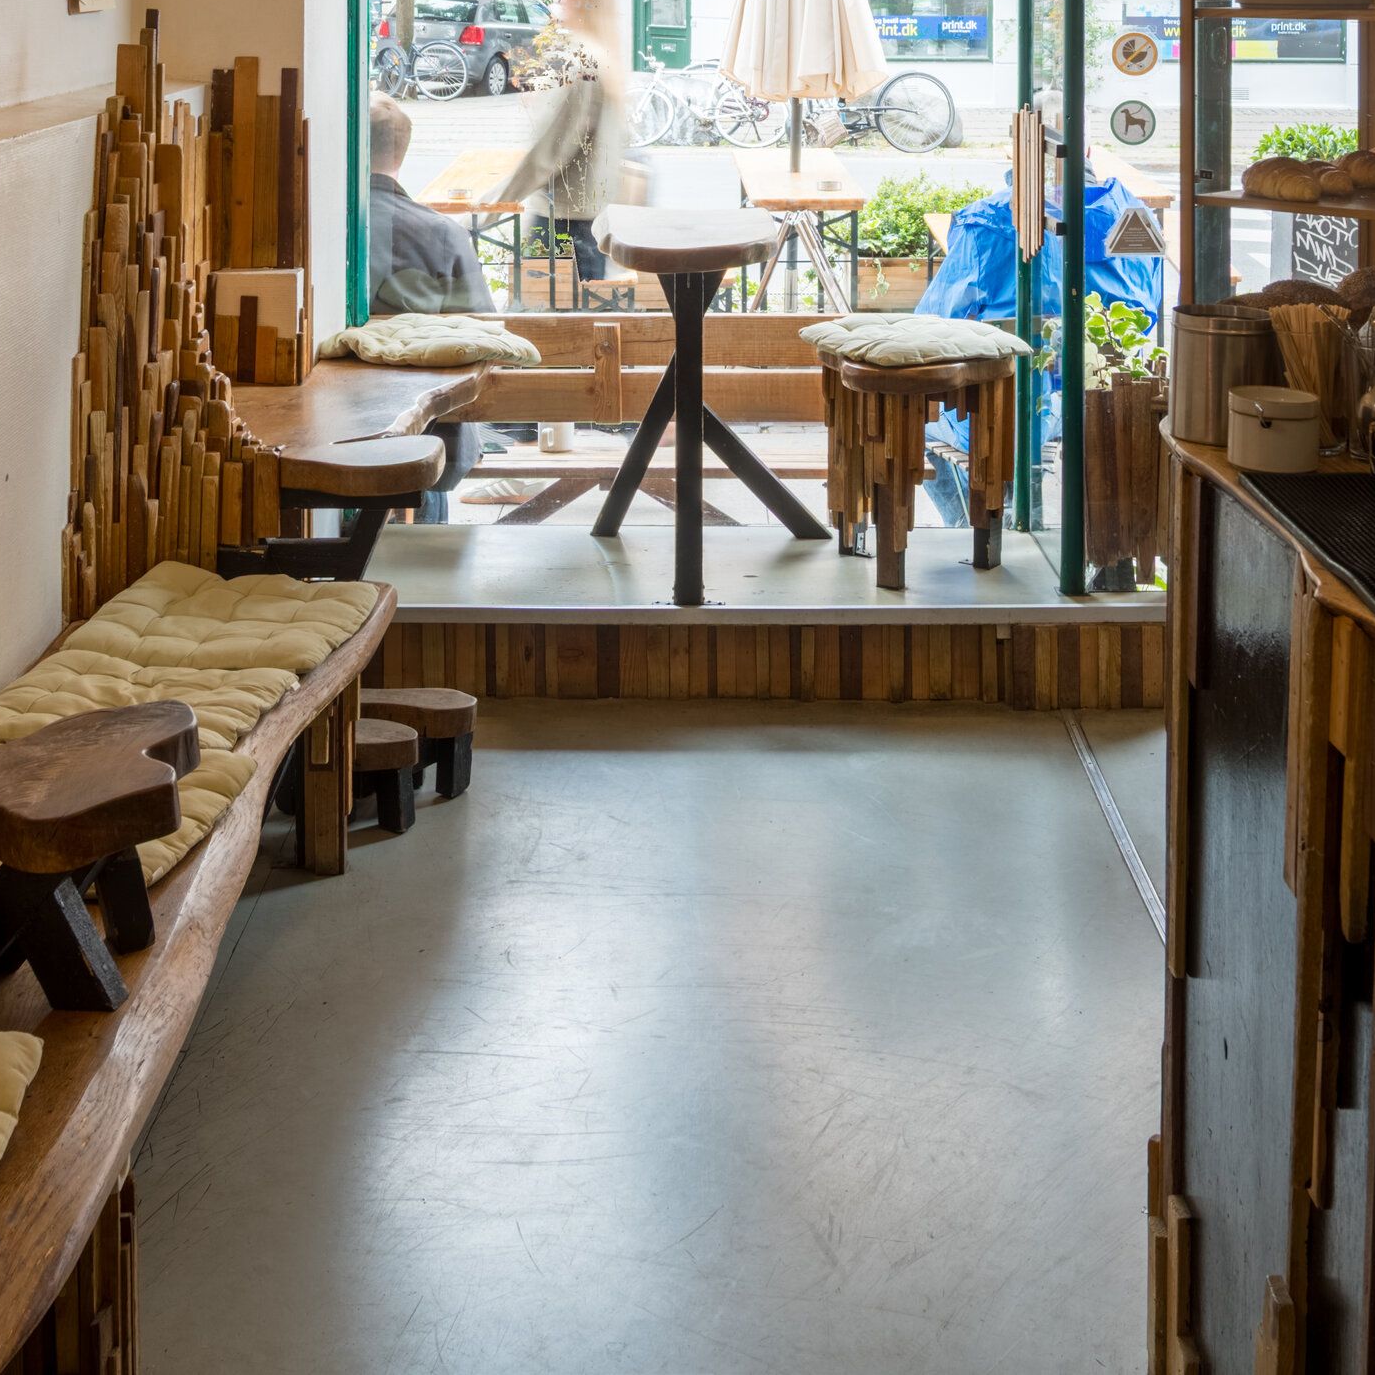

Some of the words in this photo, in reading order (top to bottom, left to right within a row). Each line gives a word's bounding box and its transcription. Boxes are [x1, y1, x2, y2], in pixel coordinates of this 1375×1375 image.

[942, 21, 977, 30] print.dk
[1271, 23, 1306, 32] print.dk
[875, 25, 917, 36] rint.dk
